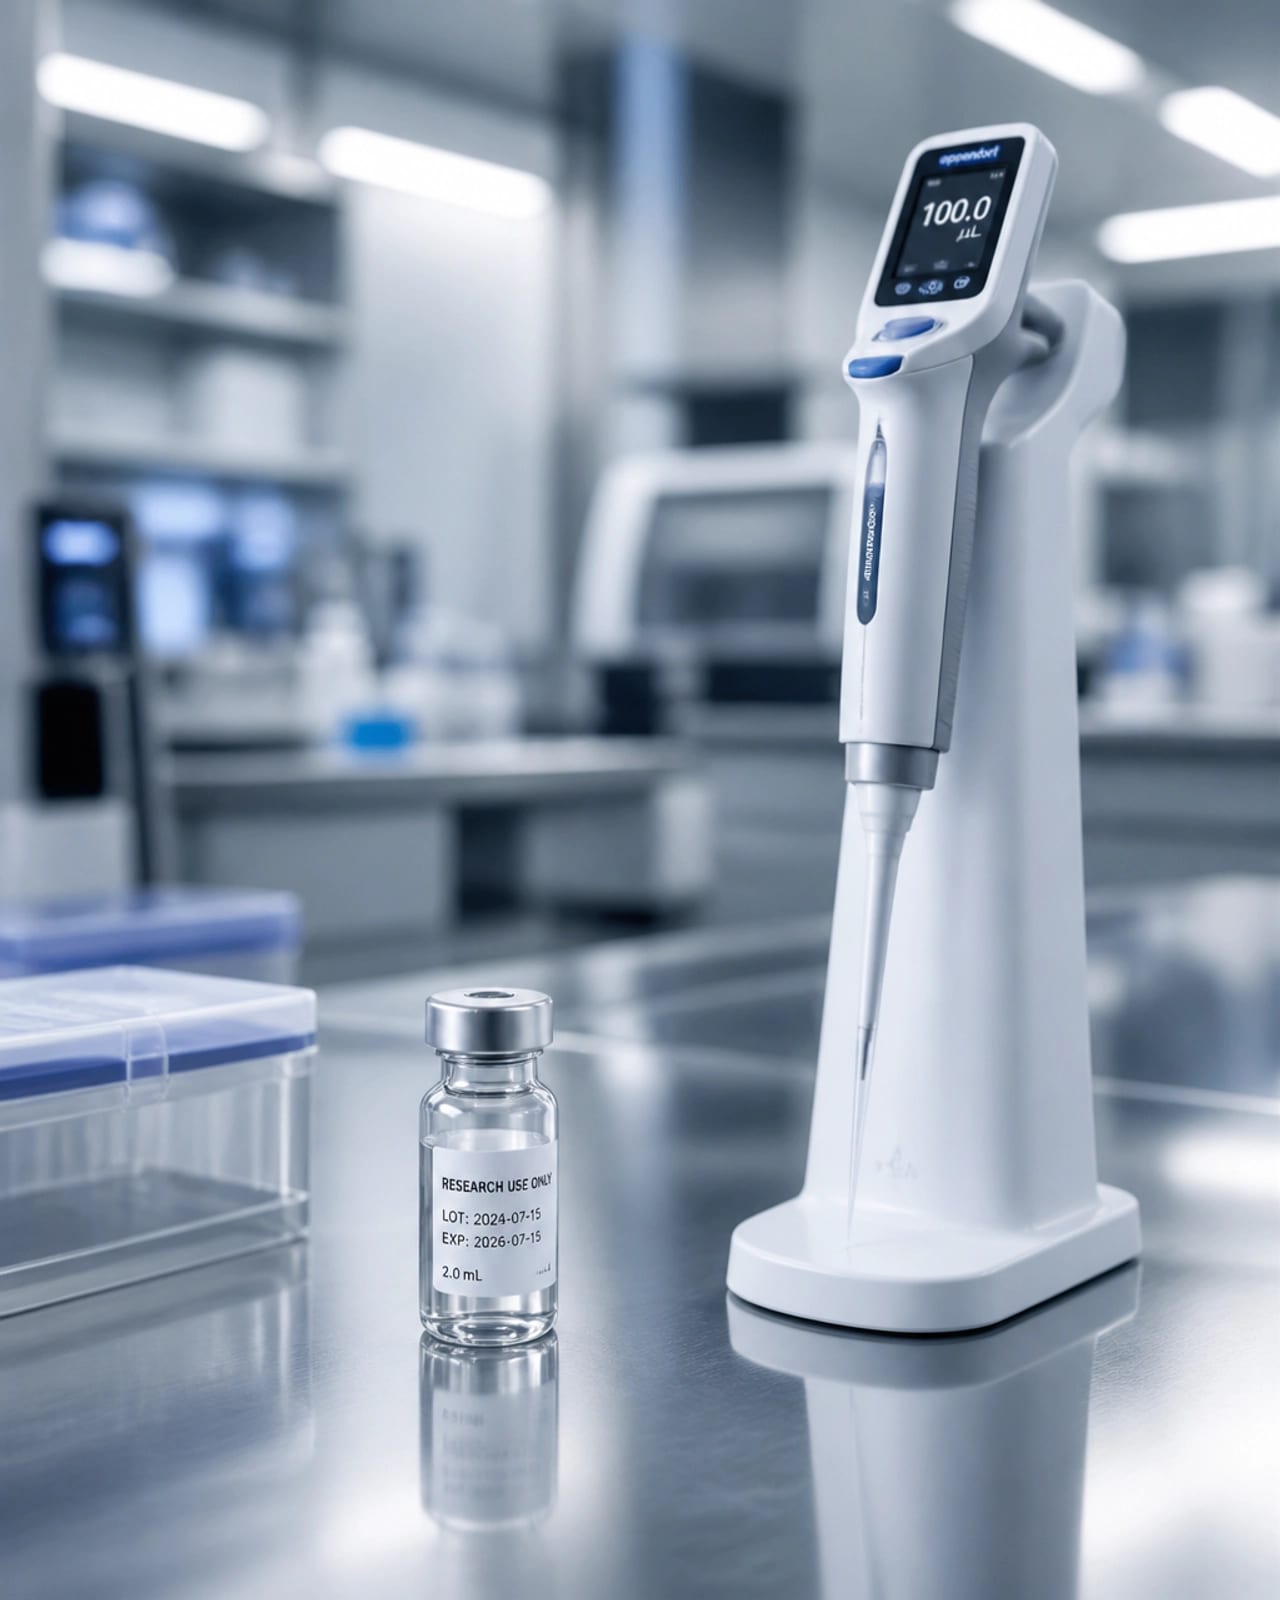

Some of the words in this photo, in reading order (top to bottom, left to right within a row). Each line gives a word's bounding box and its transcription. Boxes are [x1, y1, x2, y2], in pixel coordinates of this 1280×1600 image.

[923, 196, 992, 227] 100.0
[442, 1177, 504, 1193] RESEARCH
[508, 1178, 529, 1193] USE
[531, 1172, 552, 1189] ONLY
[442, 1208, 469, 1225] LOT:
[473, 1207, 541, 1226] 2024-07-15
[442, 1232, 469, 1247] EXP:
[474, 1230, 541, 1248] 2026-07-15
[442, 1265, 460, 1280] 2.0
[463, 1269, 483, 1282] mL
